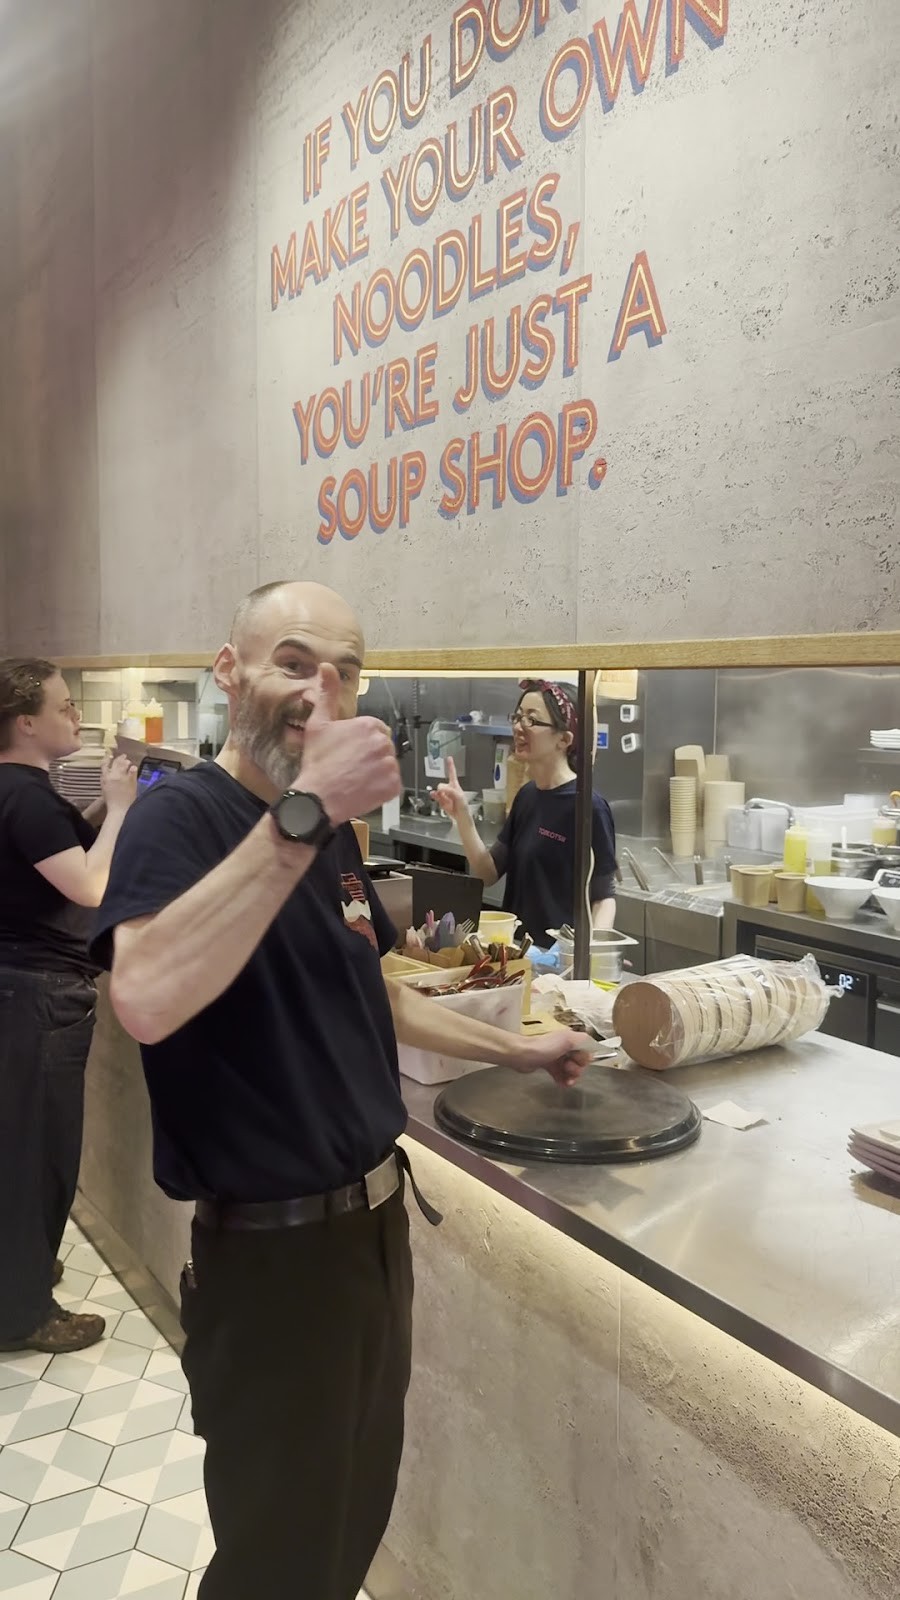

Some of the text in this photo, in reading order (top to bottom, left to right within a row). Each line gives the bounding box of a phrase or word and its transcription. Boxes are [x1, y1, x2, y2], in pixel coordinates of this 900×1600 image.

[271, 0, 728, 310] MAKE YOUR OWN
[303, 116, 332, 204] IF
[341, 34, 432, 170] YOU
[292, 250, 667, 465] YOU'RE JUST A
[333, 172, 580, 365] NOODLES,
[317, 398, 607, 545] SOUP SHOP.
